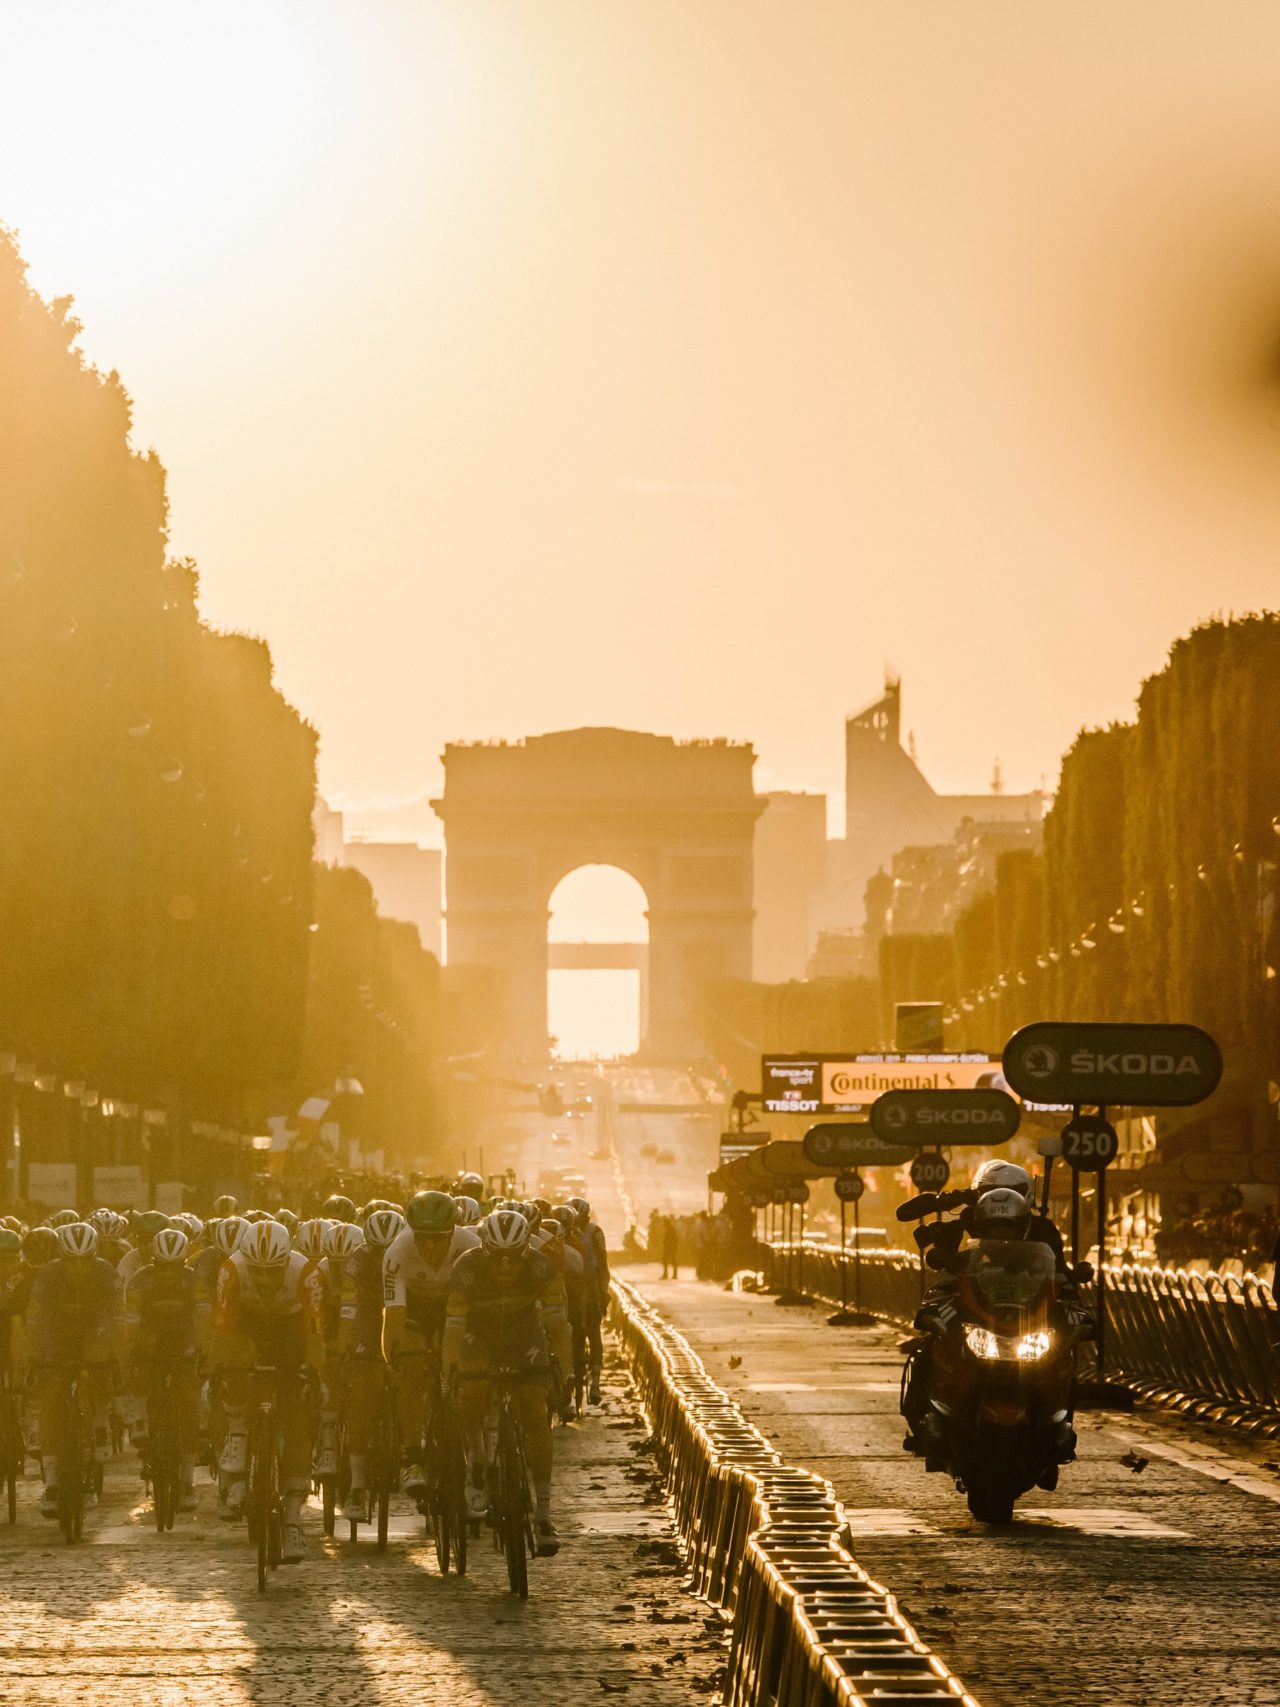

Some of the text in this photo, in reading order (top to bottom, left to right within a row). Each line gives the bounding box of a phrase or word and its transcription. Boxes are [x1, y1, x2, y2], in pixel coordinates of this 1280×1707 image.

[1071, 1049, 1202, 1075] ŠKODA
[830, 1071, 938, 1095] Continental
[765, 1100, 820, 1111] TISSOT
[916, 1106, 1007, 1124] ŠKODA
[1068, 1132, 1112, 1156] 250
[914, 1165, 947, 1180] 200
[385, 1259, 401, 1300] BMC
